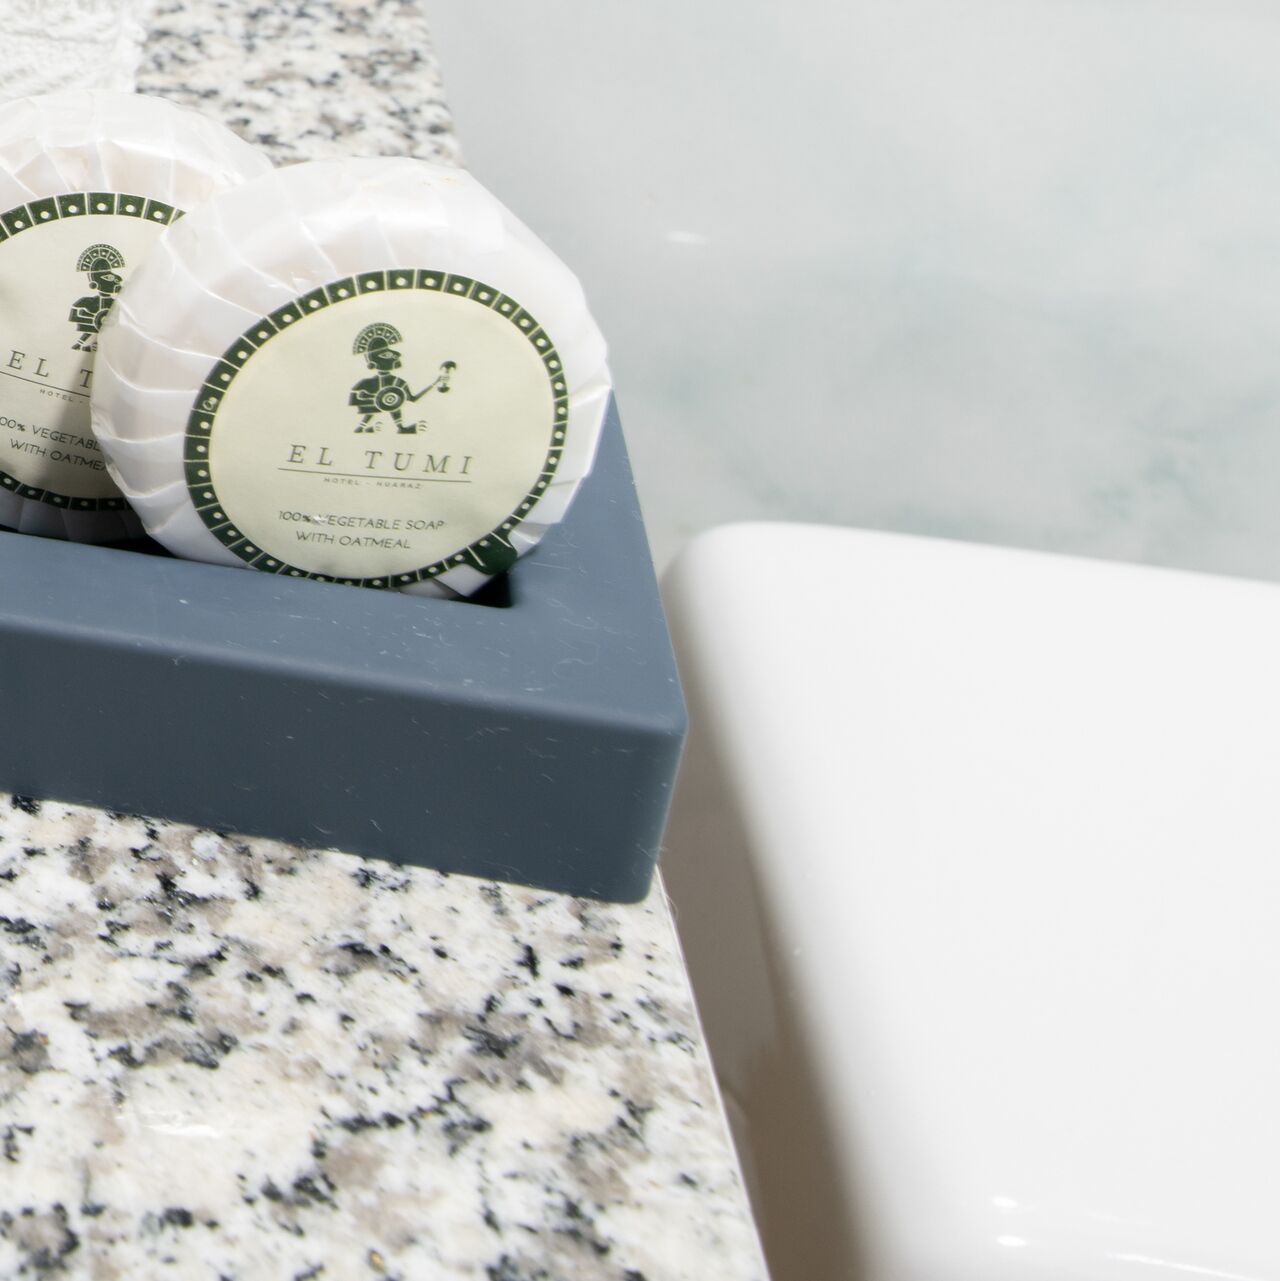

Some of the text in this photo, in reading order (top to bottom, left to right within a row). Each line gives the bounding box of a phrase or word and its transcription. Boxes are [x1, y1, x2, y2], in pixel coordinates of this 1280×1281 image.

[6, 349, 49, 378] EL
[39, 389, 74, 403] HOTEL
[10, 438, 47, 460] WITH
[287, 443, 473, 475] EL TUMI
[324, 477, 360, 486] HOTEL
[375, 481, 423, 489] HUARAZ
[404, 519, 444, 532] SOAP
[296, 530, 411, 549] WITH OATMEAL
